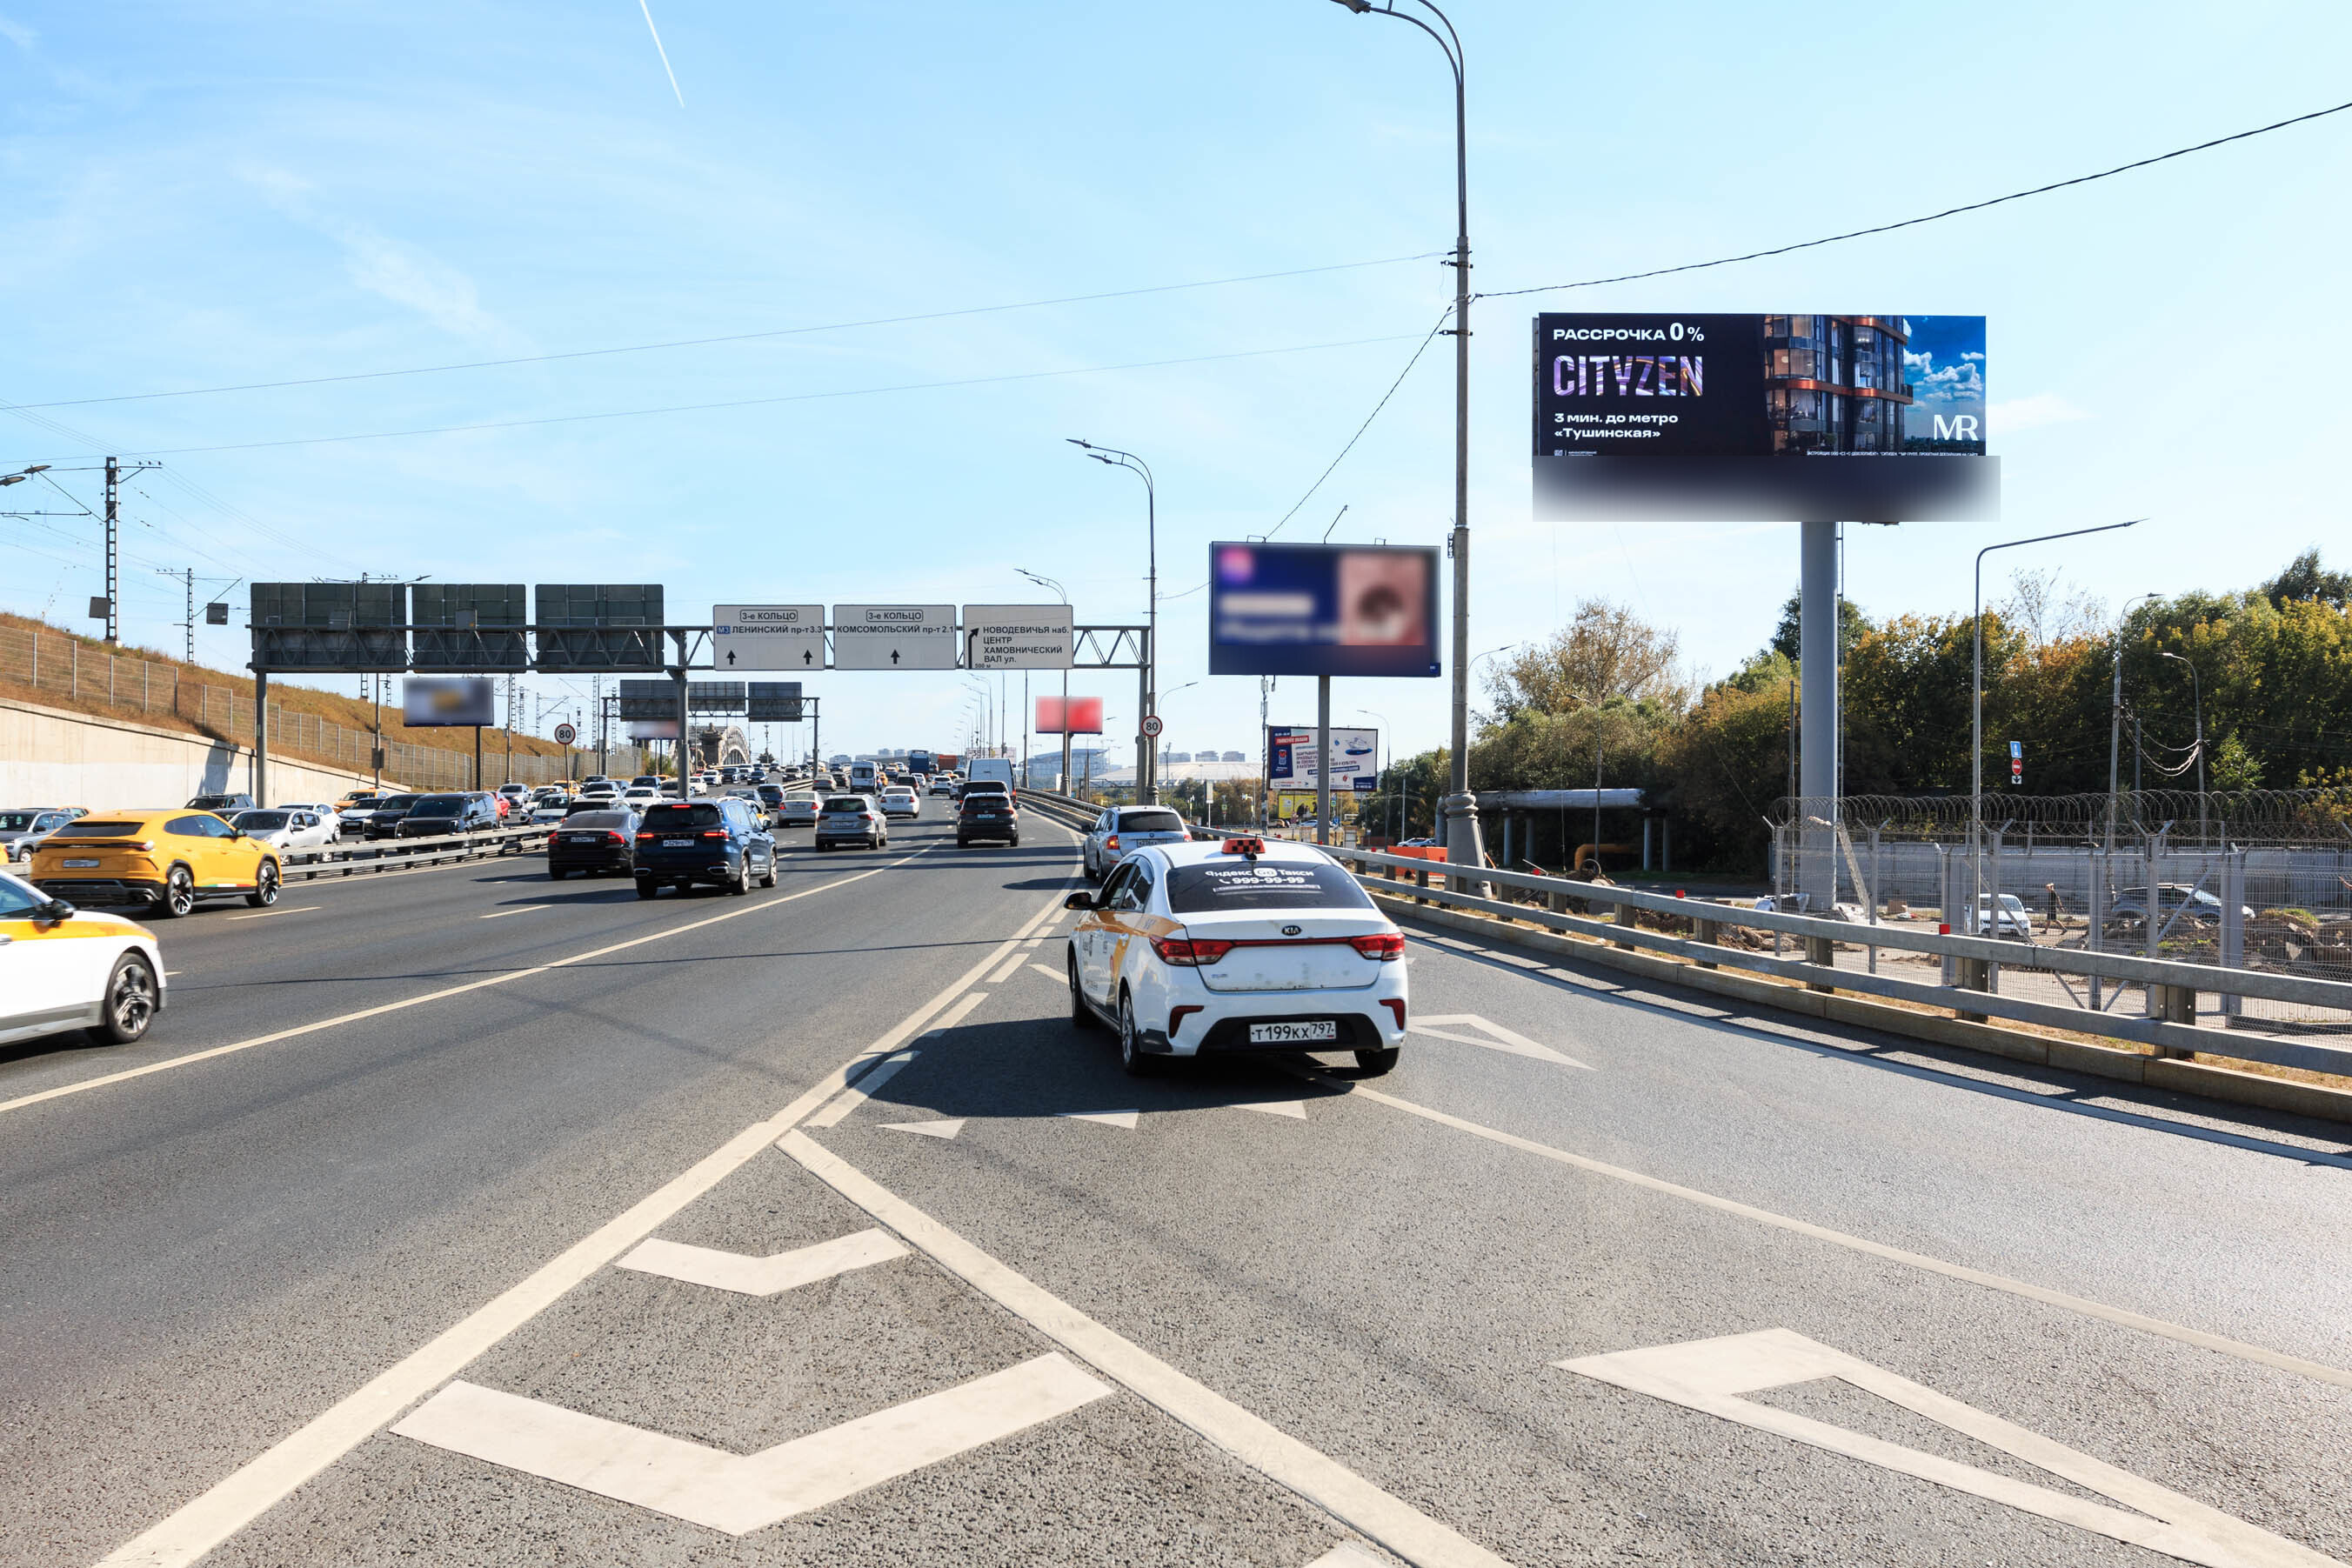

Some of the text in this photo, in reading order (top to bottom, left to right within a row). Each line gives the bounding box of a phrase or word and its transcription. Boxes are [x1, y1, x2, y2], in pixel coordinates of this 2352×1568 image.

[1554, 329, 1667, 341] РАССРОЧКА
[1554, 355, 1703, 397] CITYZEN
[1554, 413, 1679, 426] 3 мин. до метро
[1934, 414, 1979, 441] MR
[1554, 428, 1661, 441] «Тушинская»
[758, 612, 796, 621] КОЛЬЦО
[884, 611, 922, 621] КОЛЬЦО
[732, 624, 789, 634] ЛЕНИНСКИЙ
[791, 626, 810, 635] пр-т
[837, 624, 920, 633] КОМСОМОЛЬСКИЙ
[922, 626, 940, 635] пр-т
[983, 626, 1050, 635] НОВОДЕВИЧЬЯ
[983, 636, 1012, 645] ЦЕНТР
[984, 645, 1063, 654] ХАМОВНИЧЕСКИЙ
[1004, 656, 1017, 664] ул.
[1146, 722, 1159, 731] 80
[558, 730, 571, 739] 80
